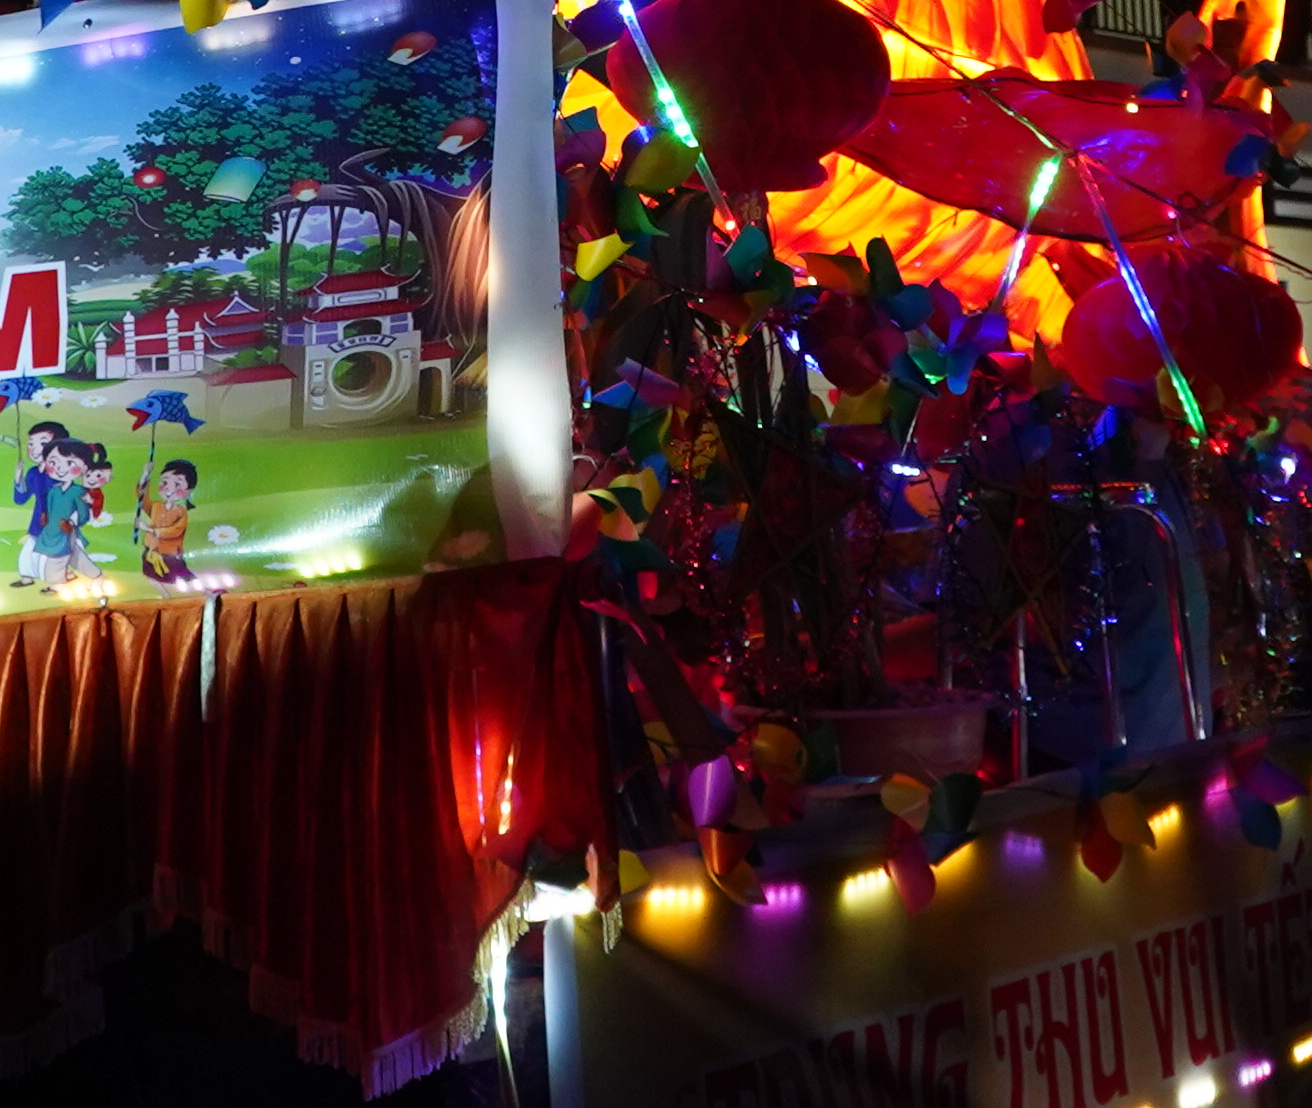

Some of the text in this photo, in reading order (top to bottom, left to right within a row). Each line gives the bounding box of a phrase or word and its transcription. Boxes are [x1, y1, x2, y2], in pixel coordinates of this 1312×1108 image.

[705, 1000, 969, 1108] UNG
[991, 951, 1129, 1108] THU
[1136, 915, 1236, 1080] VUI
